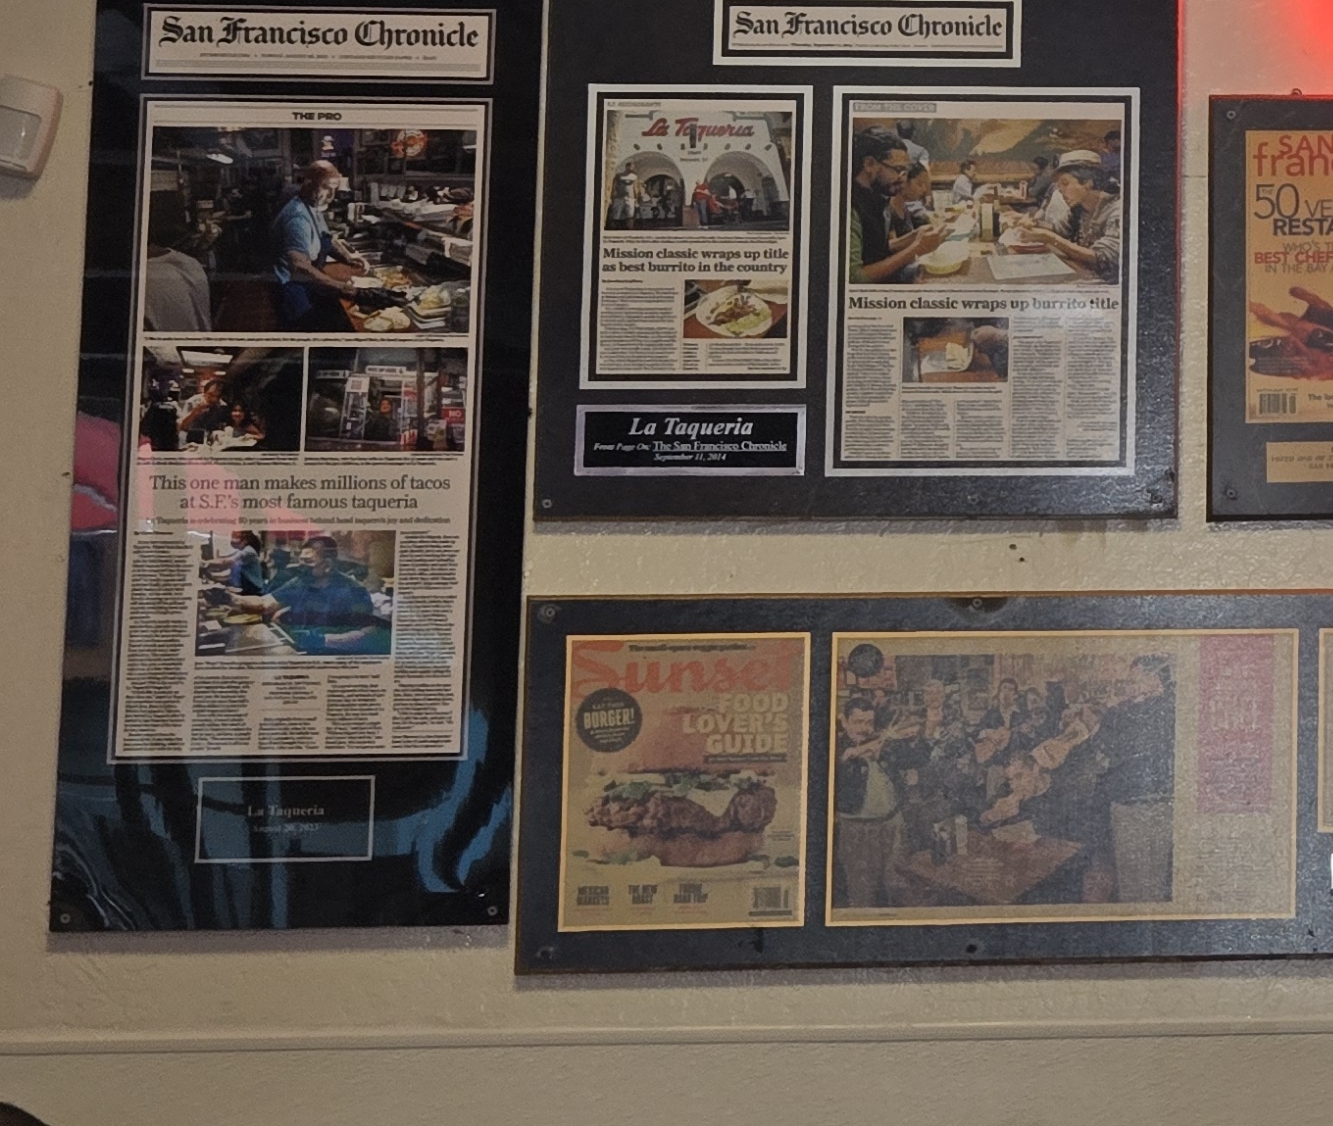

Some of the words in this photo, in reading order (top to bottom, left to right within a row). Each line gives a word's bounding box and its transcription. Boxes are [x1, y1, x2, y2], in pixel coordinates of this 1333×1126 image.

[158, 15, 216, 48] San
[215, 16, 348, 49] Francisco
[354, 19, 479, 50] Chronicle
[733, 10, 780, 39] San
[781, 11, 893, 39] Francisco
[897, 13, 1003, 40] Chronicle
[292, 111, 316, 121] THE
[317, 111, 342, 121] PRO
[641, 117, 670, 137] La
[1253, 182, 1300, 219] 50
[603, 247, 654, 260] Mission
[656, 247, 699, 260] classic
[701, 249, 742, 262] wraps
[743, 249, 761, 261] up
[763, 247, 790, 260] title
[1282, 241, 1321, 253] WHO'S
[1254, 251, 1290, 265] BEST
[602, 263, 616, 273] as
[619, 261, 646, 273] best
[648, 261, 695, 273] burrito
[698, 261, 711, 272] in
[713, 261, 735, 273] the
[736, 262, 788, 276] country
[1265, 263, 1279, 274] IN
[1282, 263, 1302, 274] THE
[1306, 263, 1329, 273] BAY
[848, 296, 907, 310] Mission
[909, 296, 958, 310] classic
[961, 297, 1007, 311] wraps
[1010, 298, 1030, 312] up
[1032, 297, 1087, 310] burrito
[627, 417, 657, 436] La
[664, 417, 754, 440] Taqueria
[150, 475, 187, 491] This
[189, 478, 221, 491] one
[224, 478, 260, 491] man
[264, 475, 317, 491] makes
[320, 474, 387, 491] millions
[390, 474, 409, 491] of
[410, 476, 451, 491] tacos
[179, 495, 197, 509] at
[199, 493, 239, 509] S.F.'s
[242, 495, 284, 509] most
[286, 493, 348, 509] famous
[351, 495, 418, 514] taqueria
[571, 640, 801, 700] Sunset
[720, 691, 789, 713] FOOD
[583, 707, 635, 730] BURGER!
[683, 712, 789, 734] LOVER'S
[705, 732, 789, 754] GUIDE
[247, 804, 264, 817] La
[268, 804, 325, 818] Taqueria
